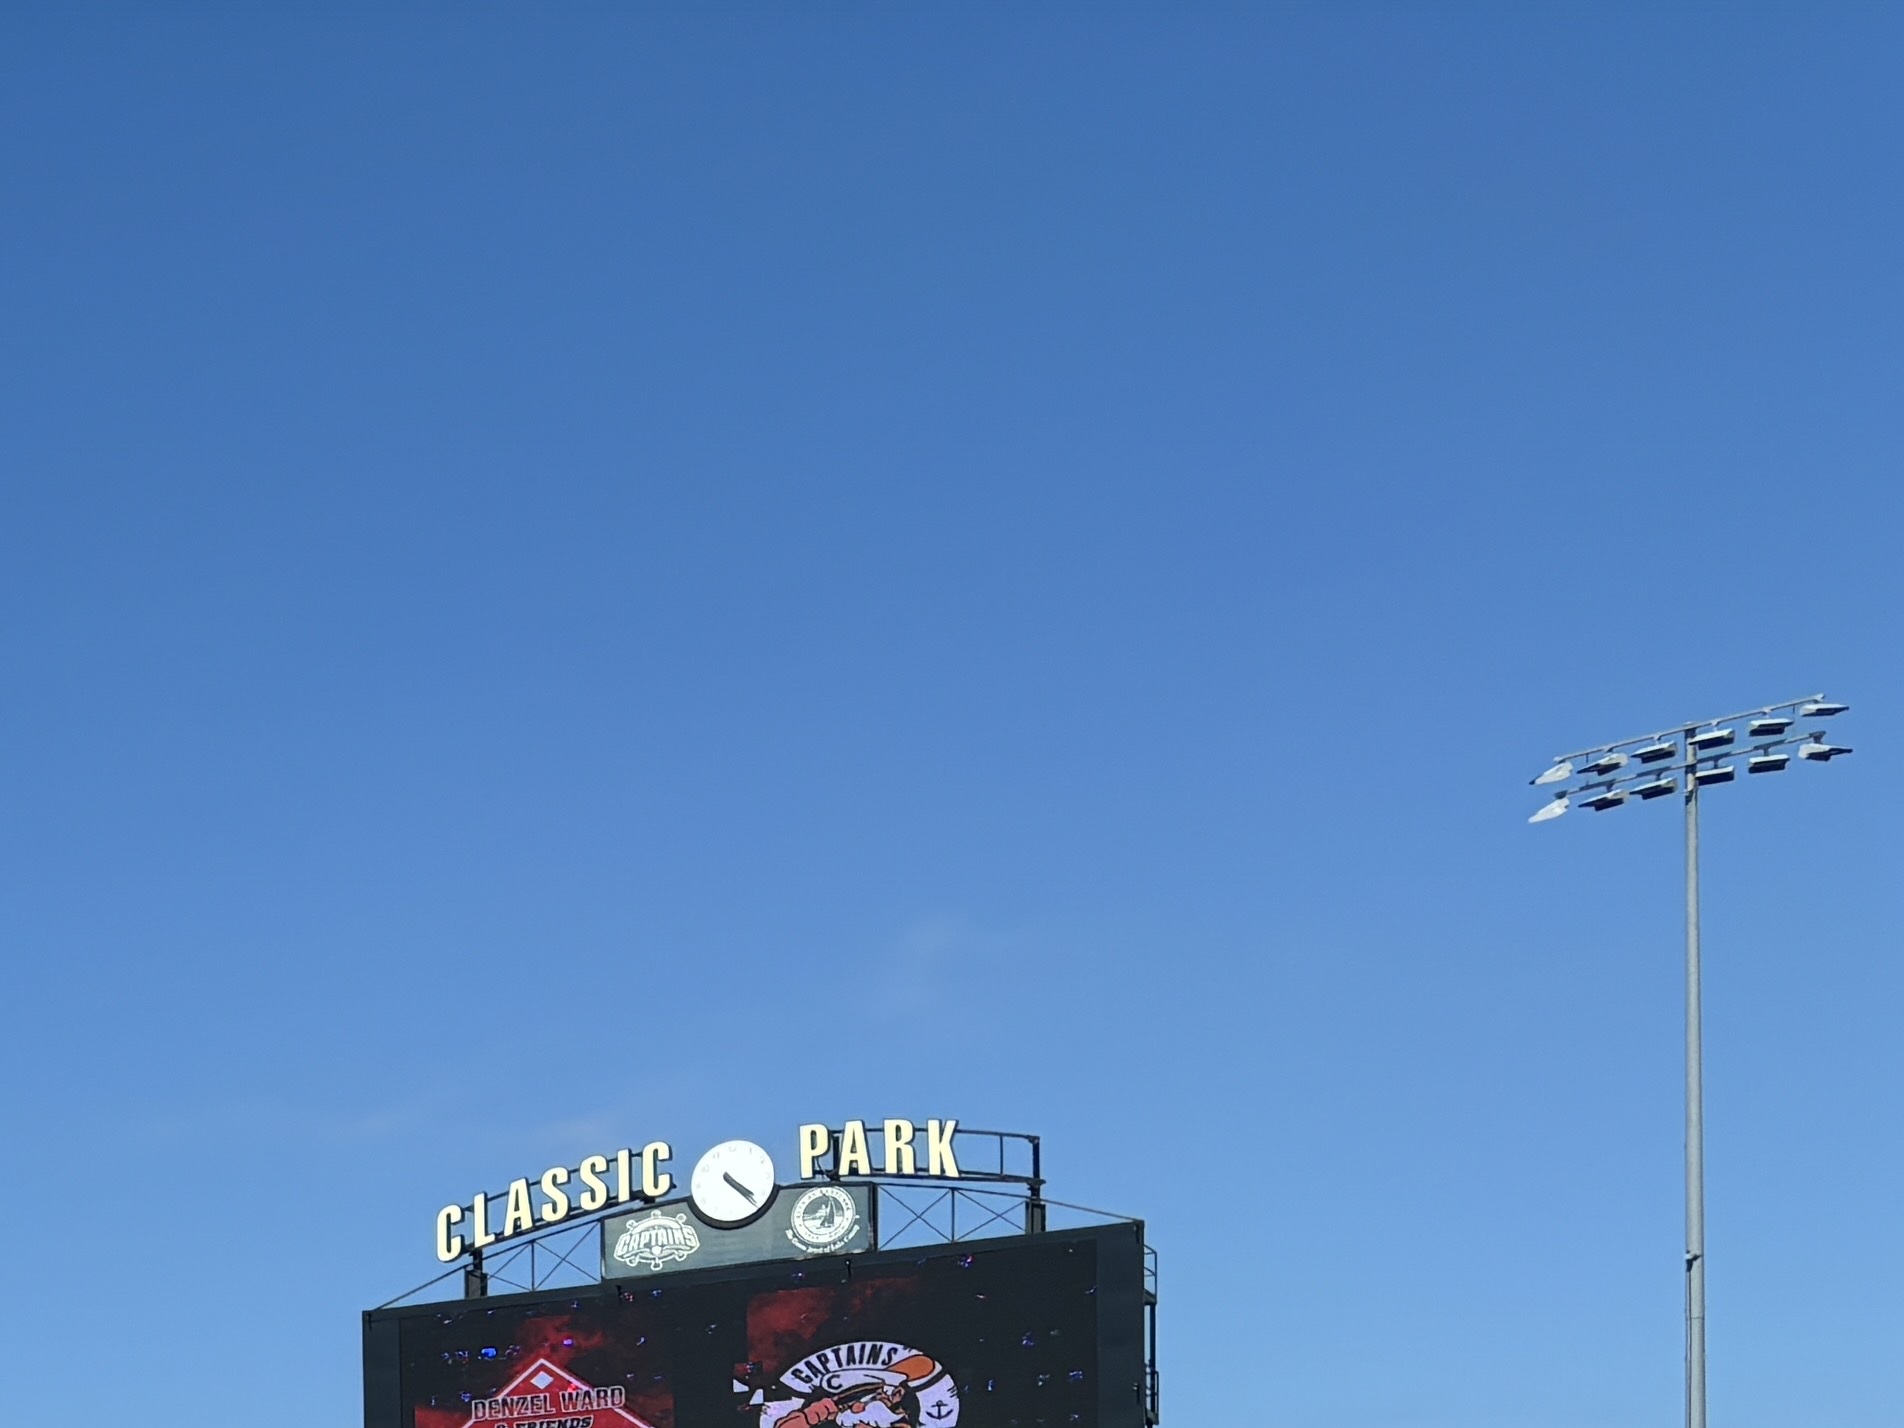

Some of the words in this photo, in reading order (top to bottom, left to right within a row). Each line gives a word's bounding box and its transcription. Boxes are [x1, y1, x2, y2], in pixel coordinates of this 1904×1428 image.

[436, 1141, 674, 1262] CLASSIC
[798, 1118, 961, 1180] PARK
[615, 1227, 698, 1257] CAPTAINS
[791, 1343, 899, 1384] CAPTAINS
[471, 1392, 556, 1421] DENZEL
[560, 1386, 626, 1412] WARD
